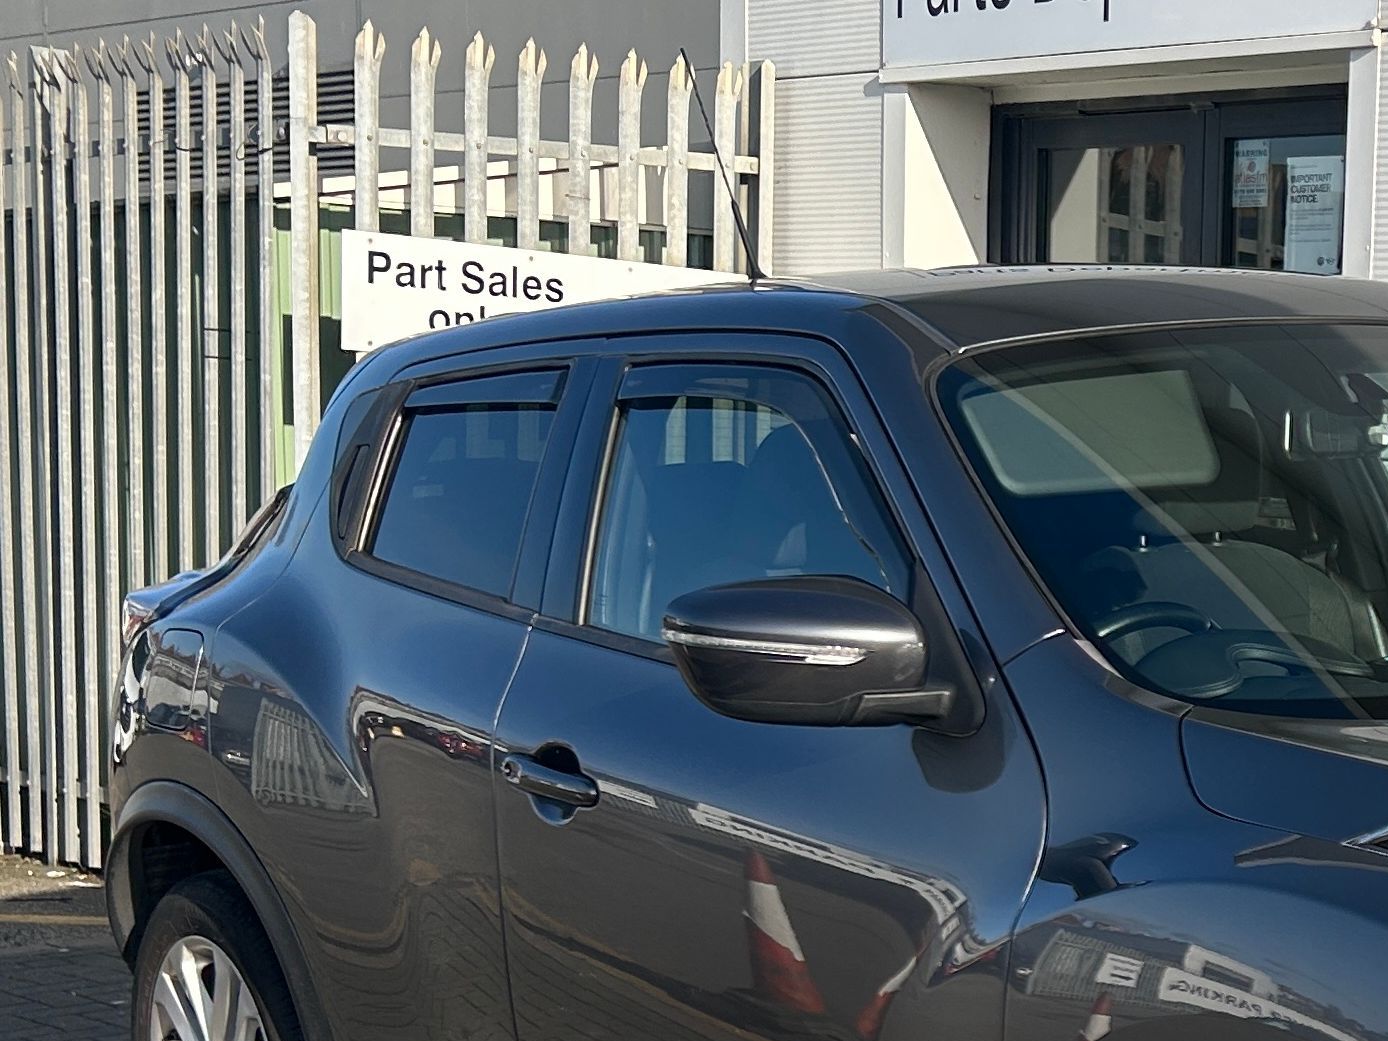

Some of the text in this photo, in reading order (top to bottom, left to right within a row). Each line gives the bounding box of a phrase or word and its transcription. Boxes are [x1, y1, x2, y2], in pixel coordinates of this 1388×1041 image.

[1291, 173, 1332, 184] IMPORTANT
[1291, 183, 1331, 194] CUSTOMER
[1291, 194, 1319, 204] NOTICE
[367, 250, 565, 303] Part Sales
